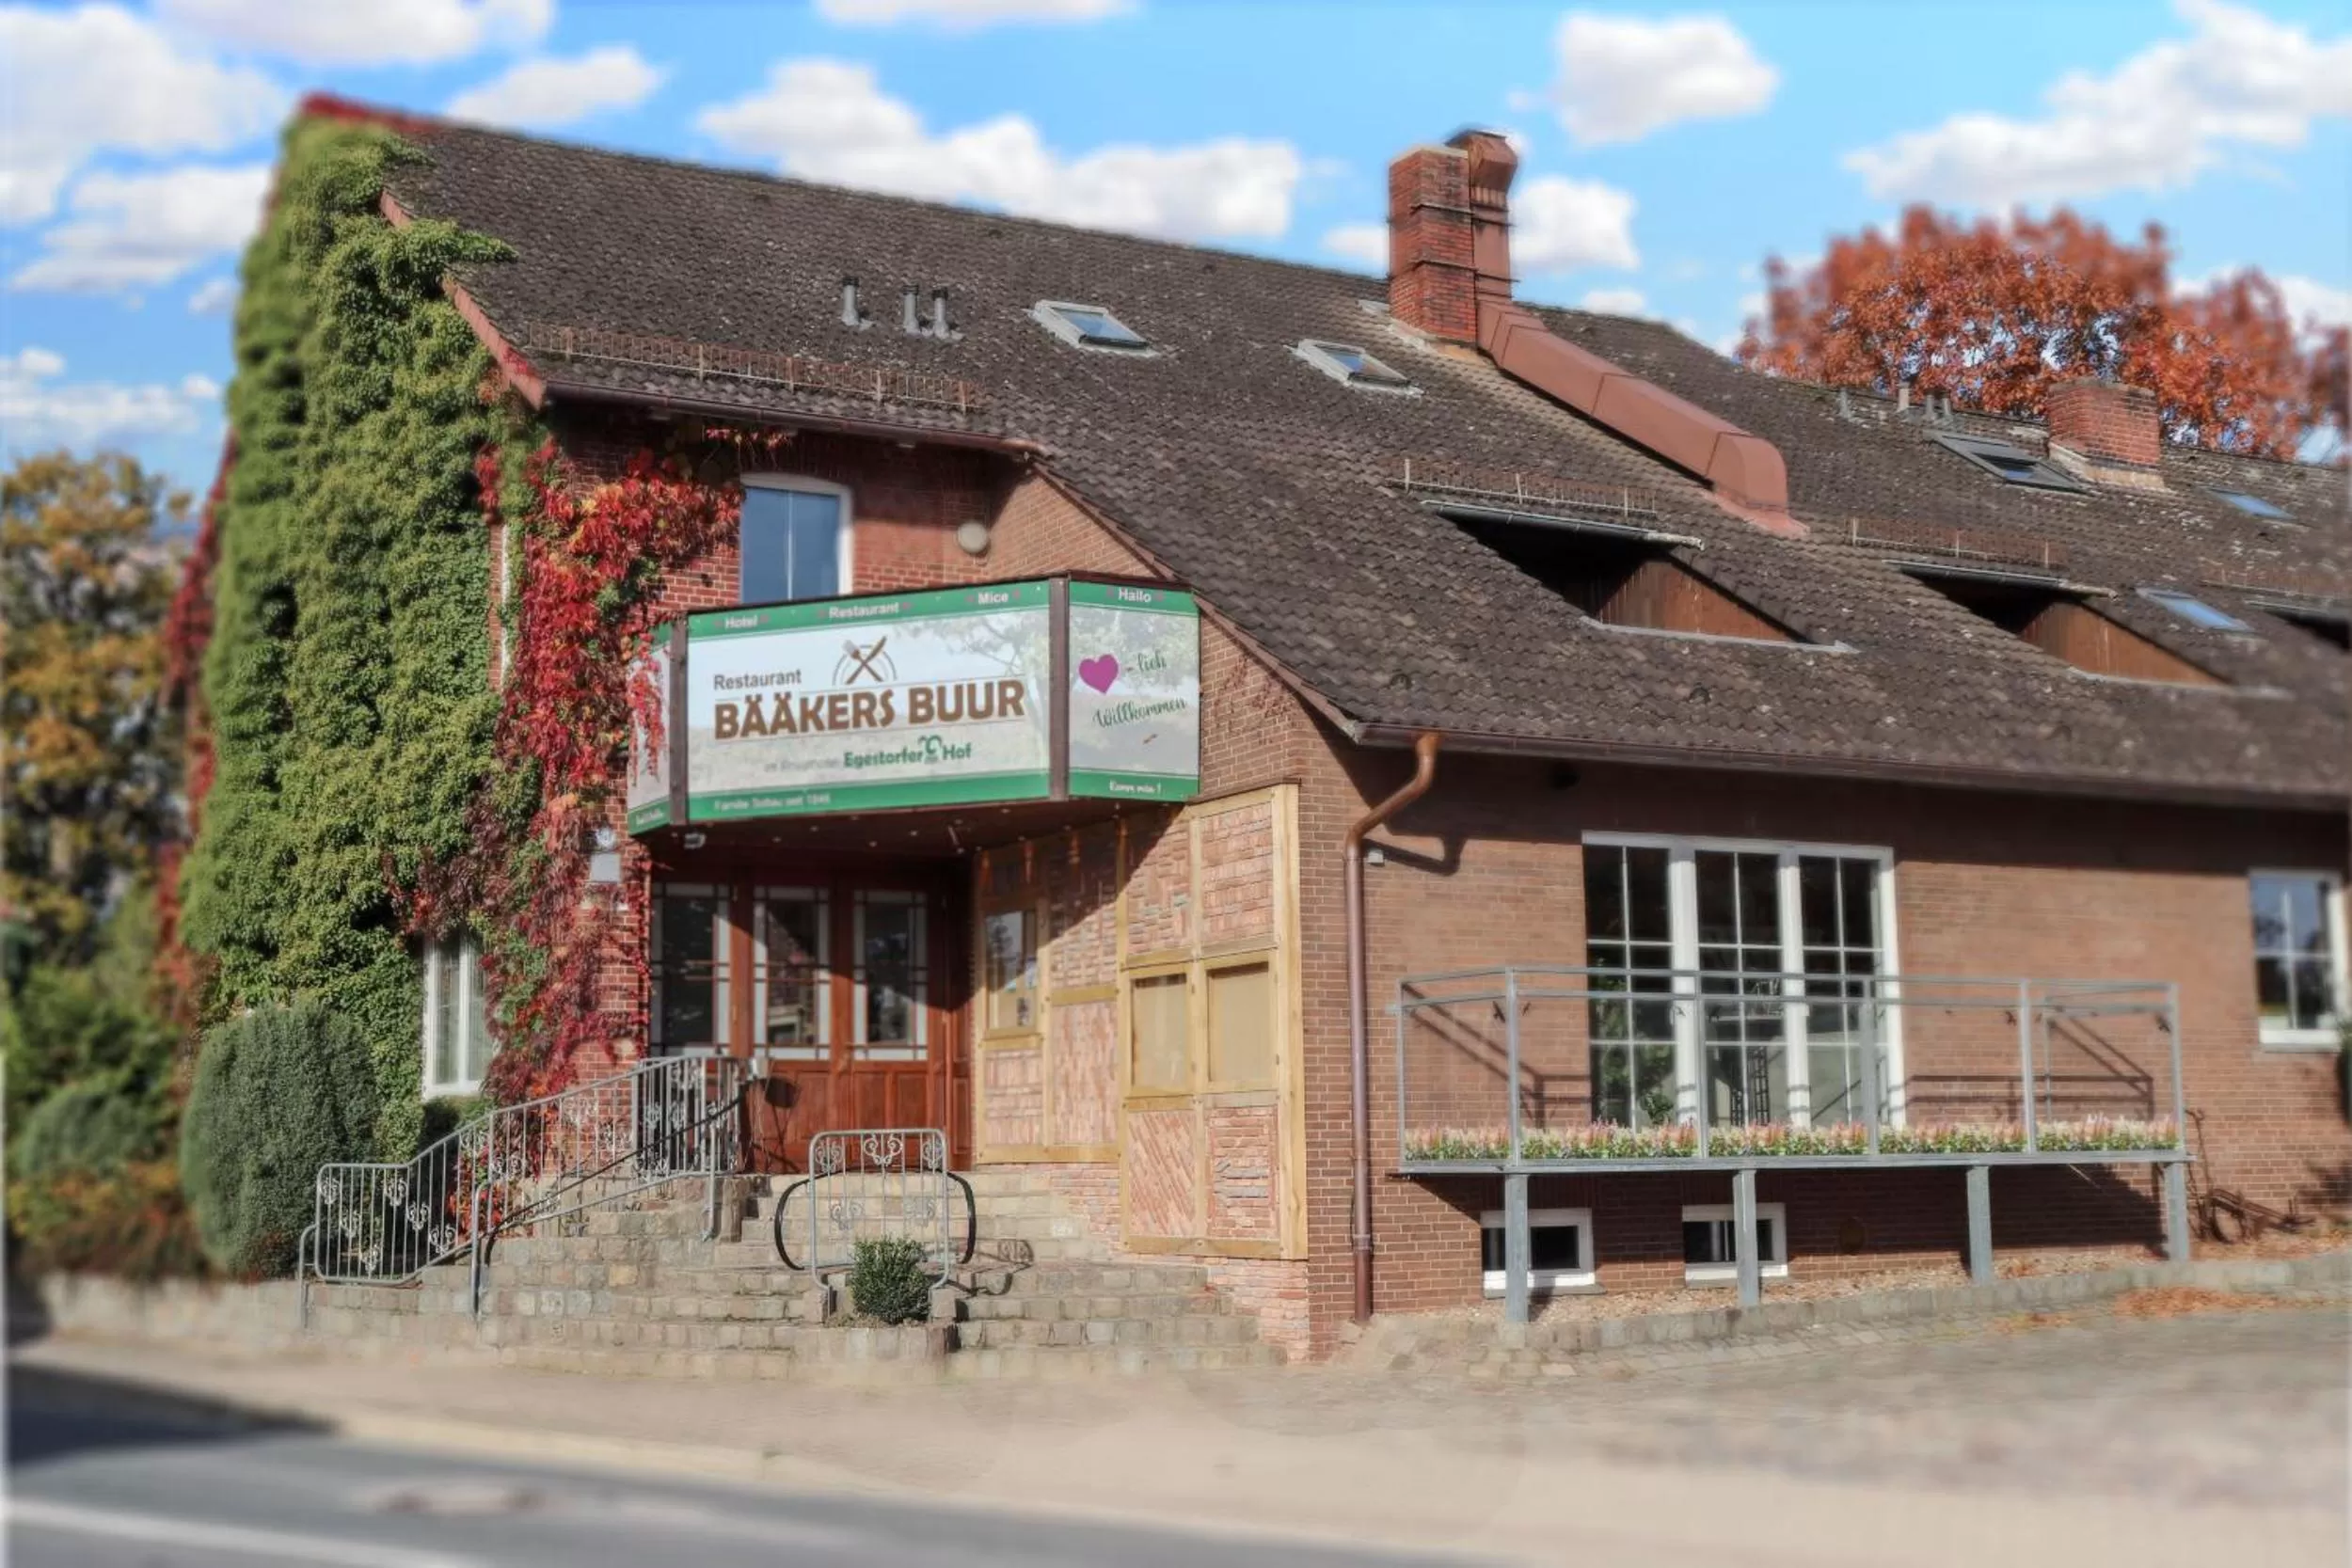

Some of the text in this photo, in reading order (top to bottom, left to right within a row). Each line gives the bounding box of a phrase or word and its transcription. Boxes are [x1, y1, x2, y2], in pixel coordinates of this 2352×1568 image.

[977, 591, 1009, 605] Mice
[1118, 587, 1152, 603] Hallo
[828, 601, 899, 619] Restaurant
[724, 615, 758, 629] Hotel
[713, 669, 803, 690] Restaurant
[714, 679, 1025, 740] BÄÄKERS BUUR
[1092, 697, 1187, 728] Willkommen
[843, 747, 924, 769] Egestorfer
[943, 743, 972, 761] Hof
